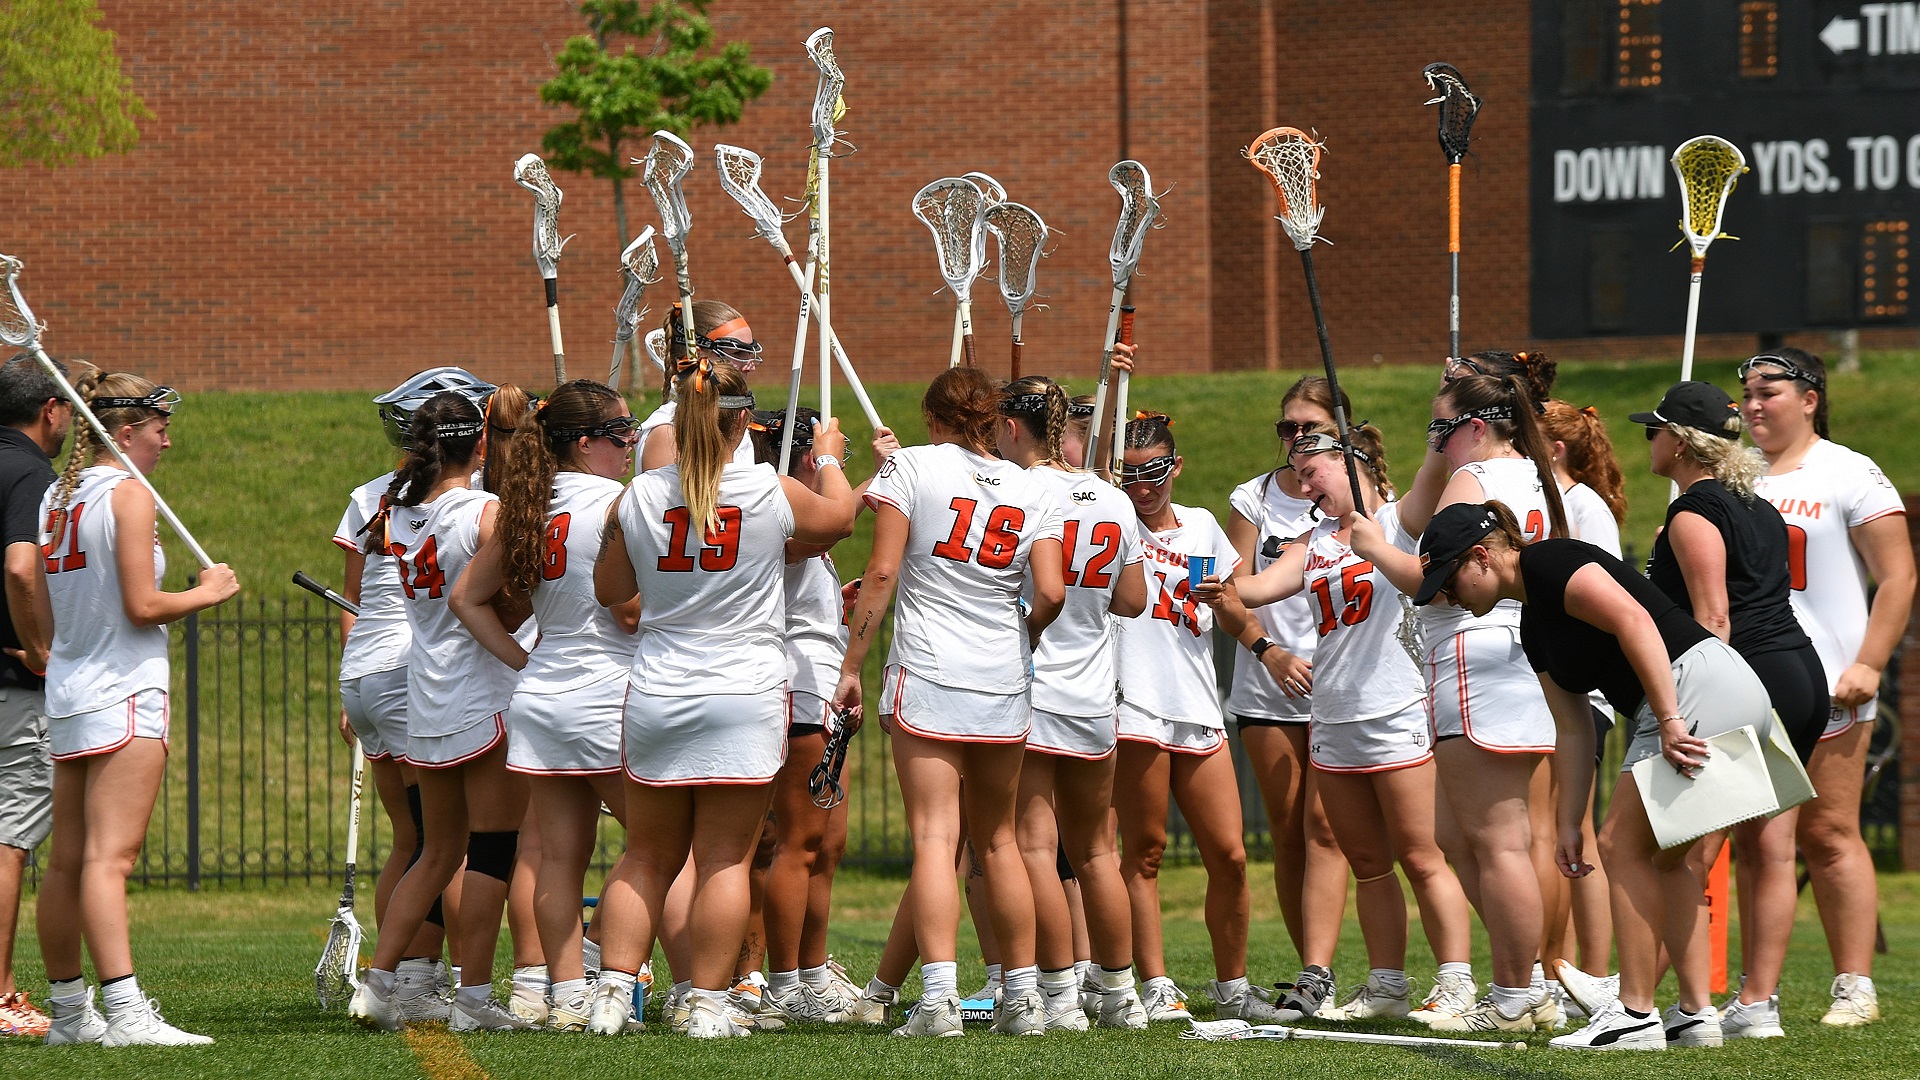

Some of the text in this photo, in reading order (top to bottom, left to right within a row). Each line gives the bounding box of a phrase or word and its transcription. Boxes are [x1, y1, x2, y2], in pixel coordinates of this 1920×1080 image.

[1553, 146, 1666, 203] DOWN
[1751, 138, 1841, 195] YDS.
[1846, 135, 1899, 191] TO
[800, 292, 809, 318] GAIT
[1021, 394, 1044, 402] STX
[1072, 491, 1097, 501] SAC
[40, 501, 87, 575] 21
[657, 505, 743, 573] 19
[931, 496, 1026, 569] 16
[1062, 519, 1122, 588] 12
[390, 533, 447, 600] 14
[1310, 559, 1374, 638] 15
